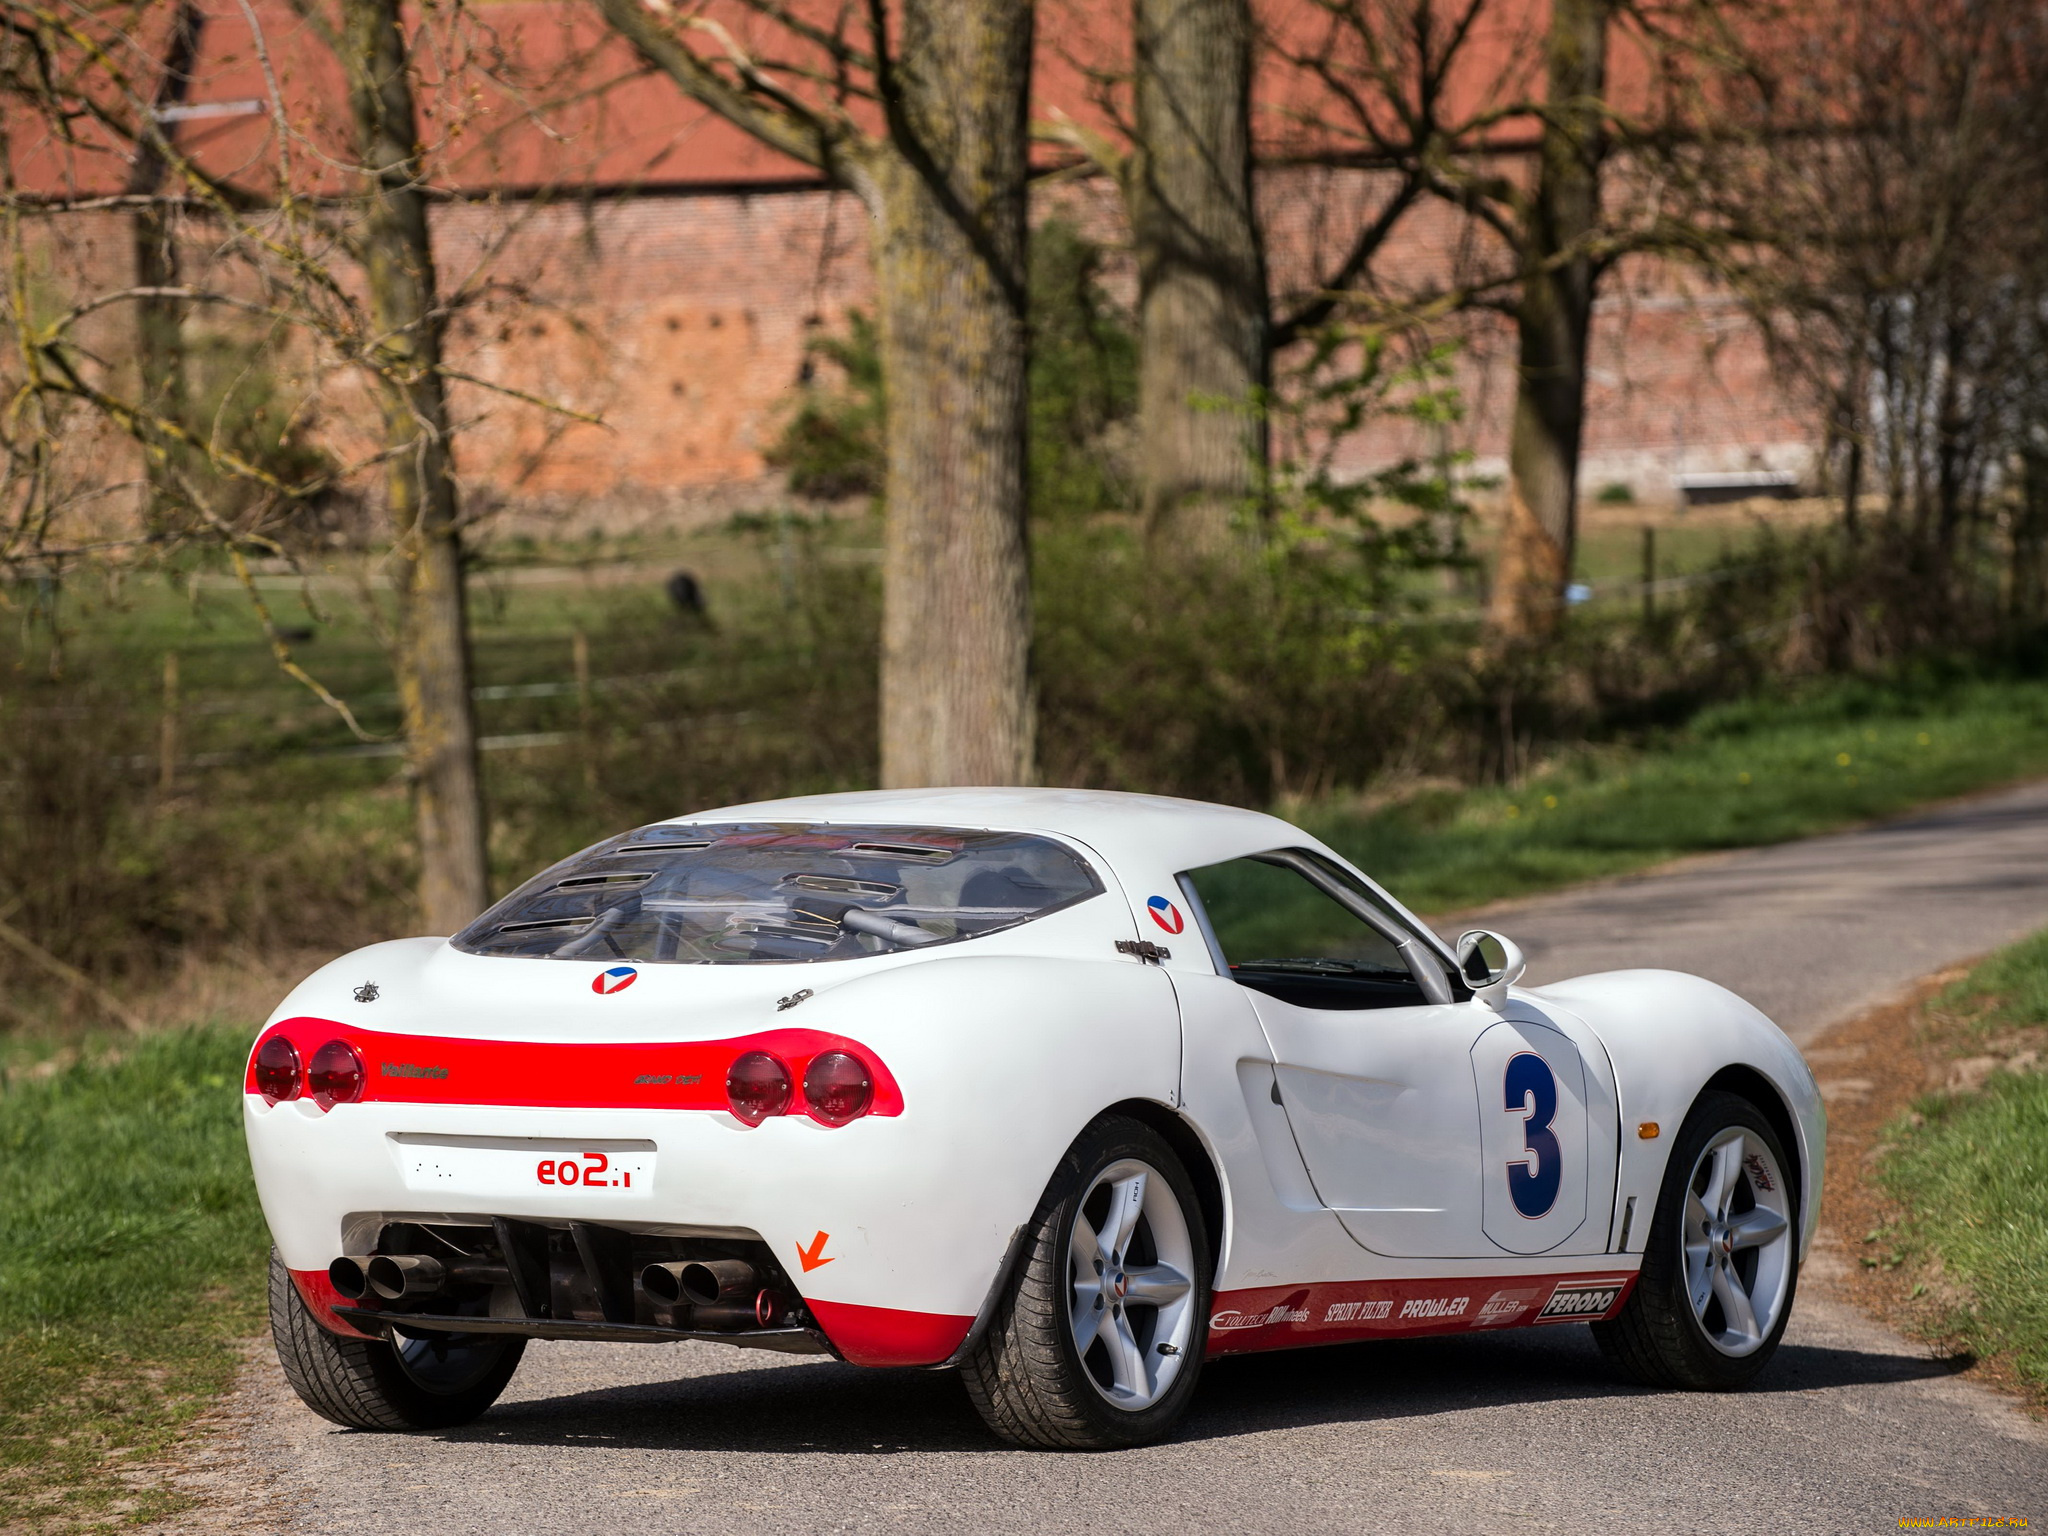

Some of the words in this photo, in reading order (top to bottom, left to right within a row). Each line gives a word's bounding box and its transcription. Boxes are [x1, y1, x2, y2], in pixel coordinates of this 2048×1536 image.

[381, 1062, 449, 1079] Vaillante
[1503, 1050, 1563, 1220] 3
[1323, 1302, 1363, 1322] SPRINT
[1357, 1300, 1394, 1320] FILTER
[1398, 1297, 1470, 1319] PROWLER
[1543, 1291, 1615, 1314] FERODO
